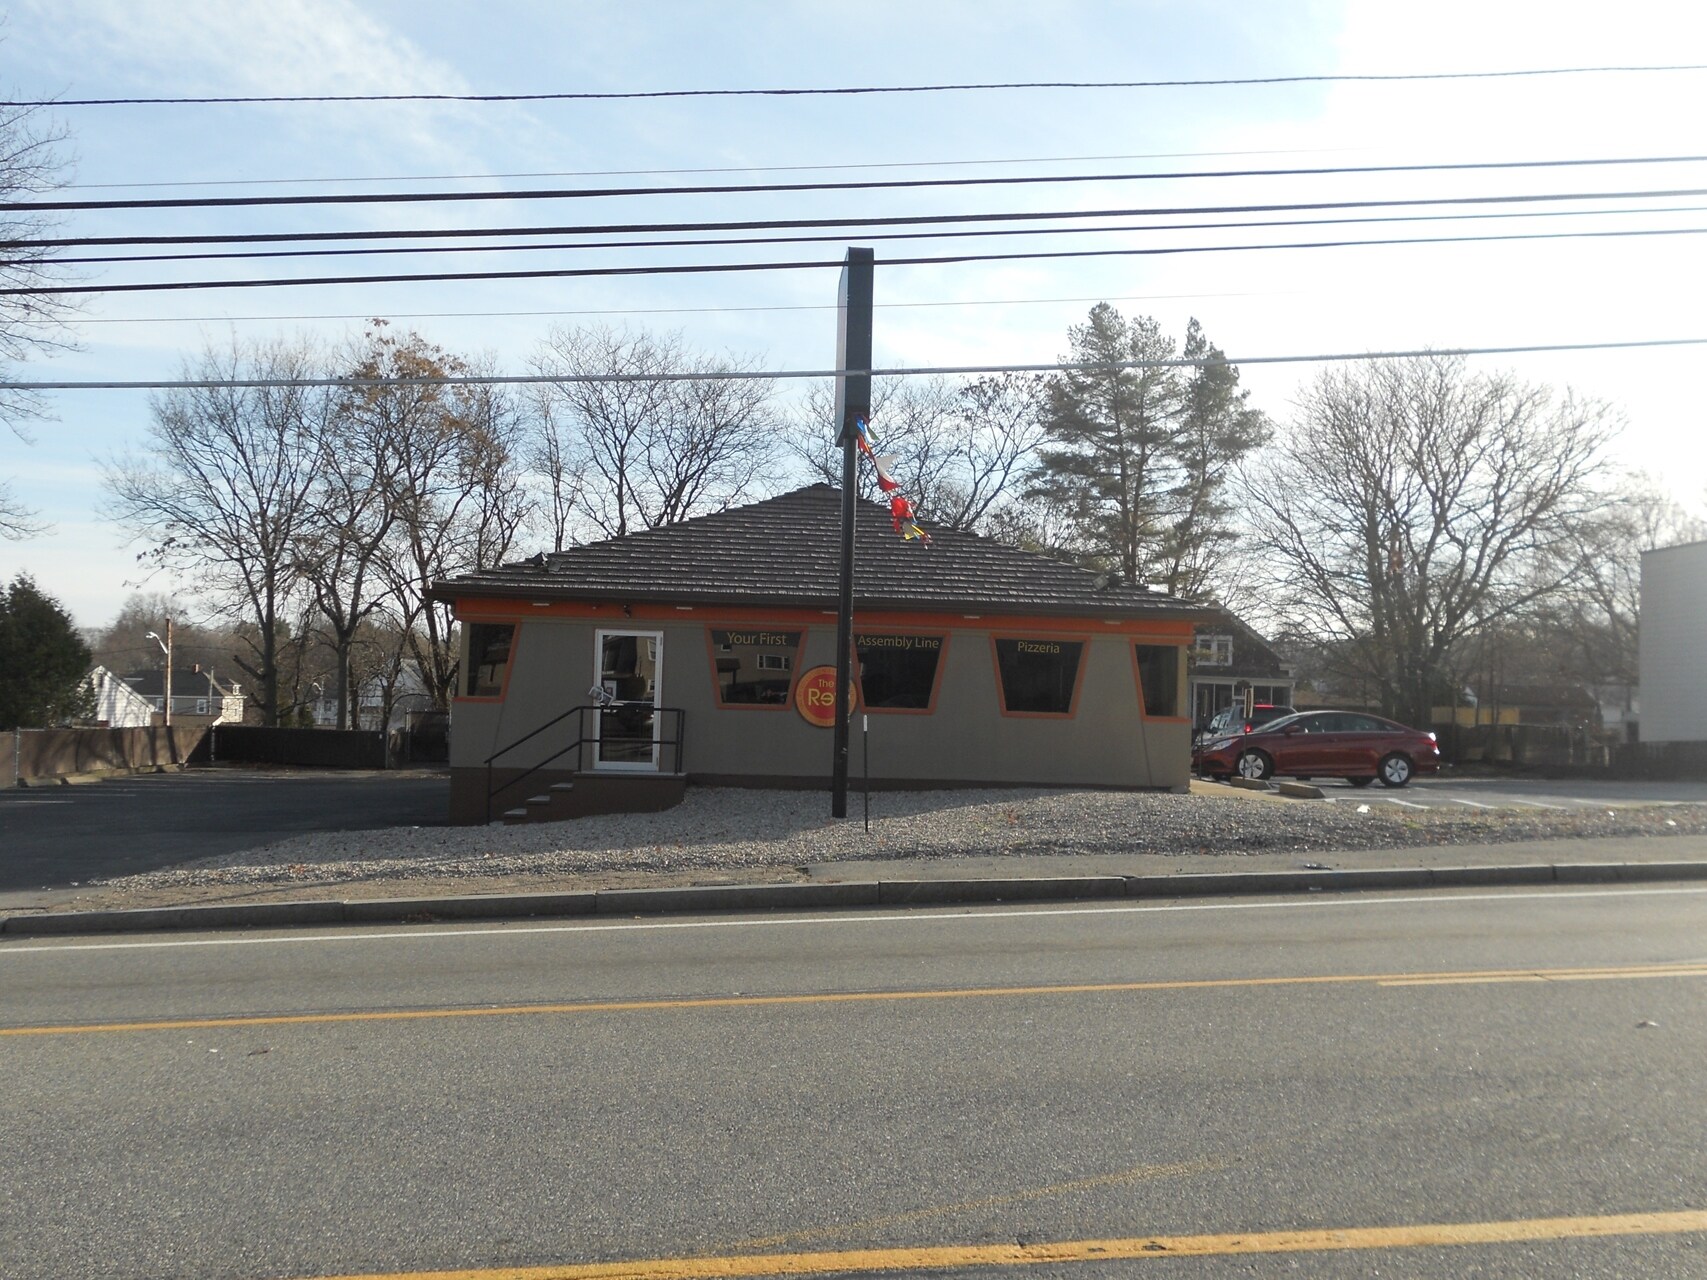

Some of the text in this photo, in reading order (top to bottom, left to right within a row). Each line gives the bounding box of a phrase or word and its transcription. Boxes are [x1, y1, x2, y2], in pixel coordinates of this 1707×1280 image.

[726, 631, 787, 646] Your First
[857, 635, 940, 650] Assembly Line
[1017, 641, 1060, 654] Pizzeria
[818, 679, 835, 688] The
[808, 688, 837, 706] Re
